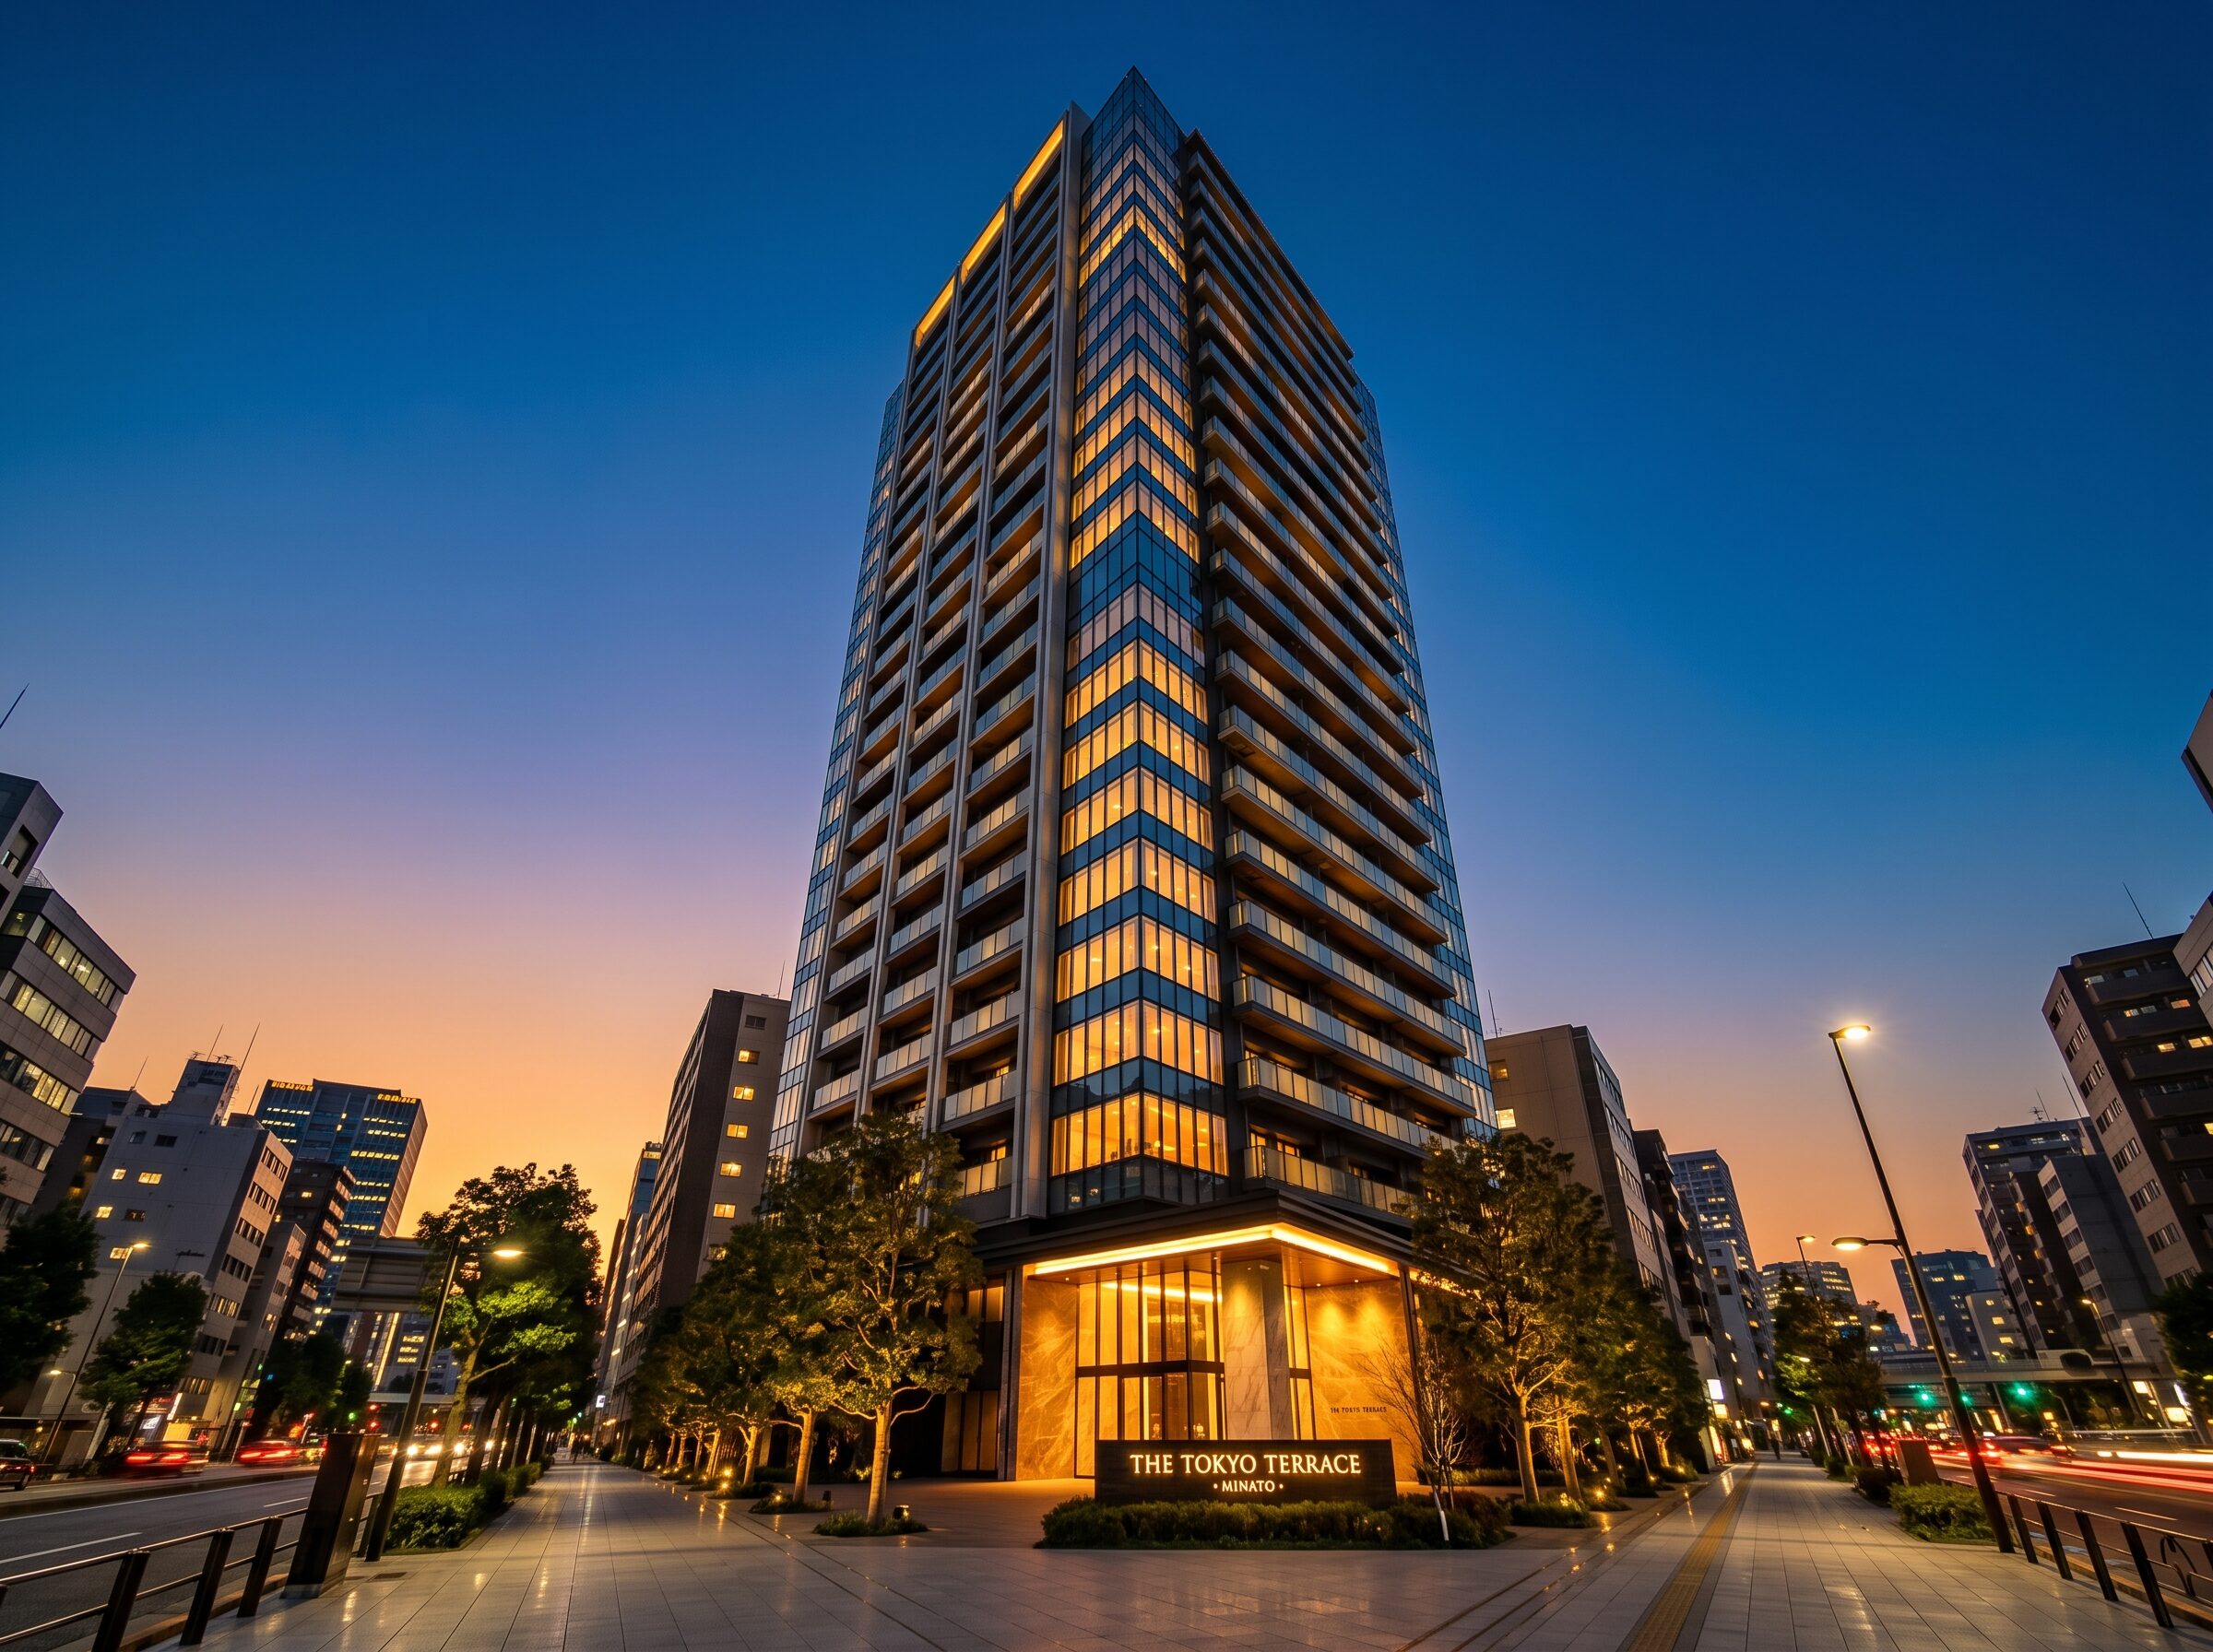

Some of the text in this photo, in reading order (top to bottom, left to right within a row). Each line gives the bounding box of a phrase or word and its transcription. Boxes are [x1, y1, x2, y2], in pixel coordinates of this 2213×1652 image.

[1130, 1454, 1362, 1474] THE TOKYO TERRACE
[1222, 1480, 1275, 1493] MINATO
